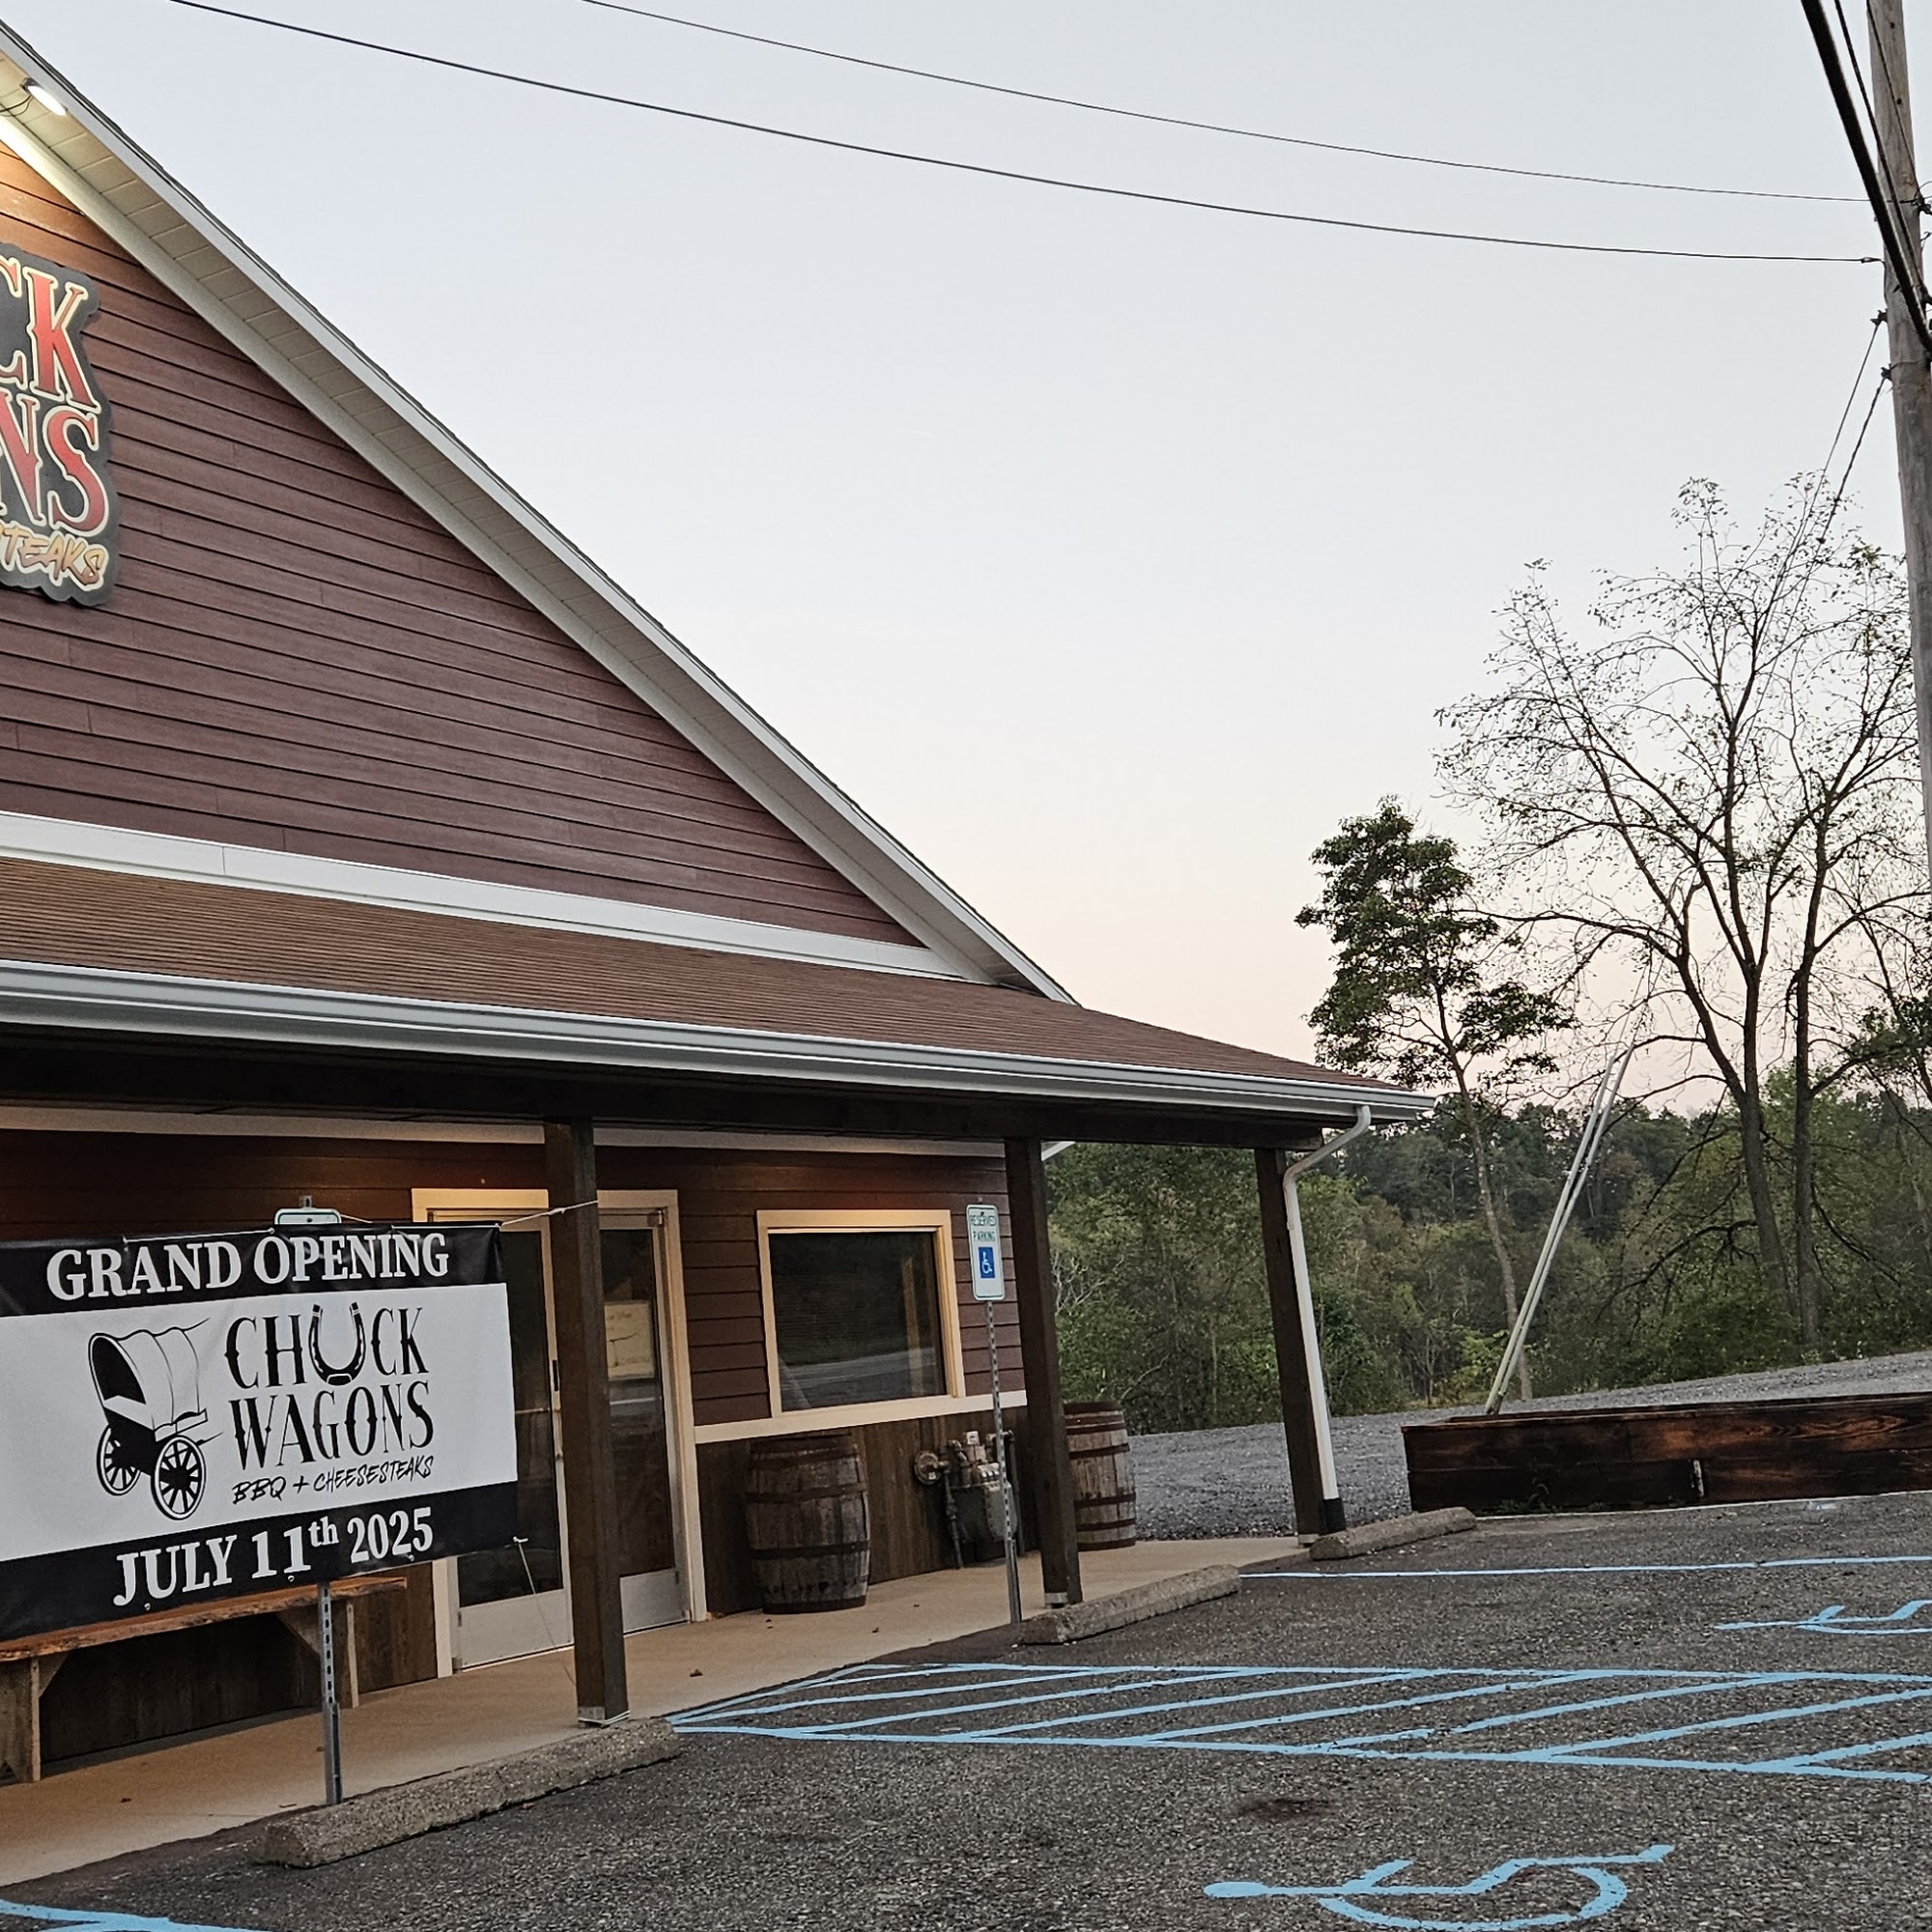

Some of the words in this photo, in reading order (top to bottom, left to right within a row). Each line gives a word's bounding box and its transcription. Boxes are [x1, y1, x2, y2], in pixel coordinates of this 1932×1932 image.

[46, 1240, 242, 1301] GRAND
[253, 1233, 449, 1285] OPENING
[224, 1301, 429, 1389] CHUCK
[228, 1380, 434, 1470] WAGONS
[232, 1476, 287, 1505] BBQ
[313, 1455, 434, 1492] CHEESESTEAKS
[113, 1535, 237, 1606] JULY
[251, 1517, 339, 1579] 11th
[347, 1507, 434, 1563] 2025
